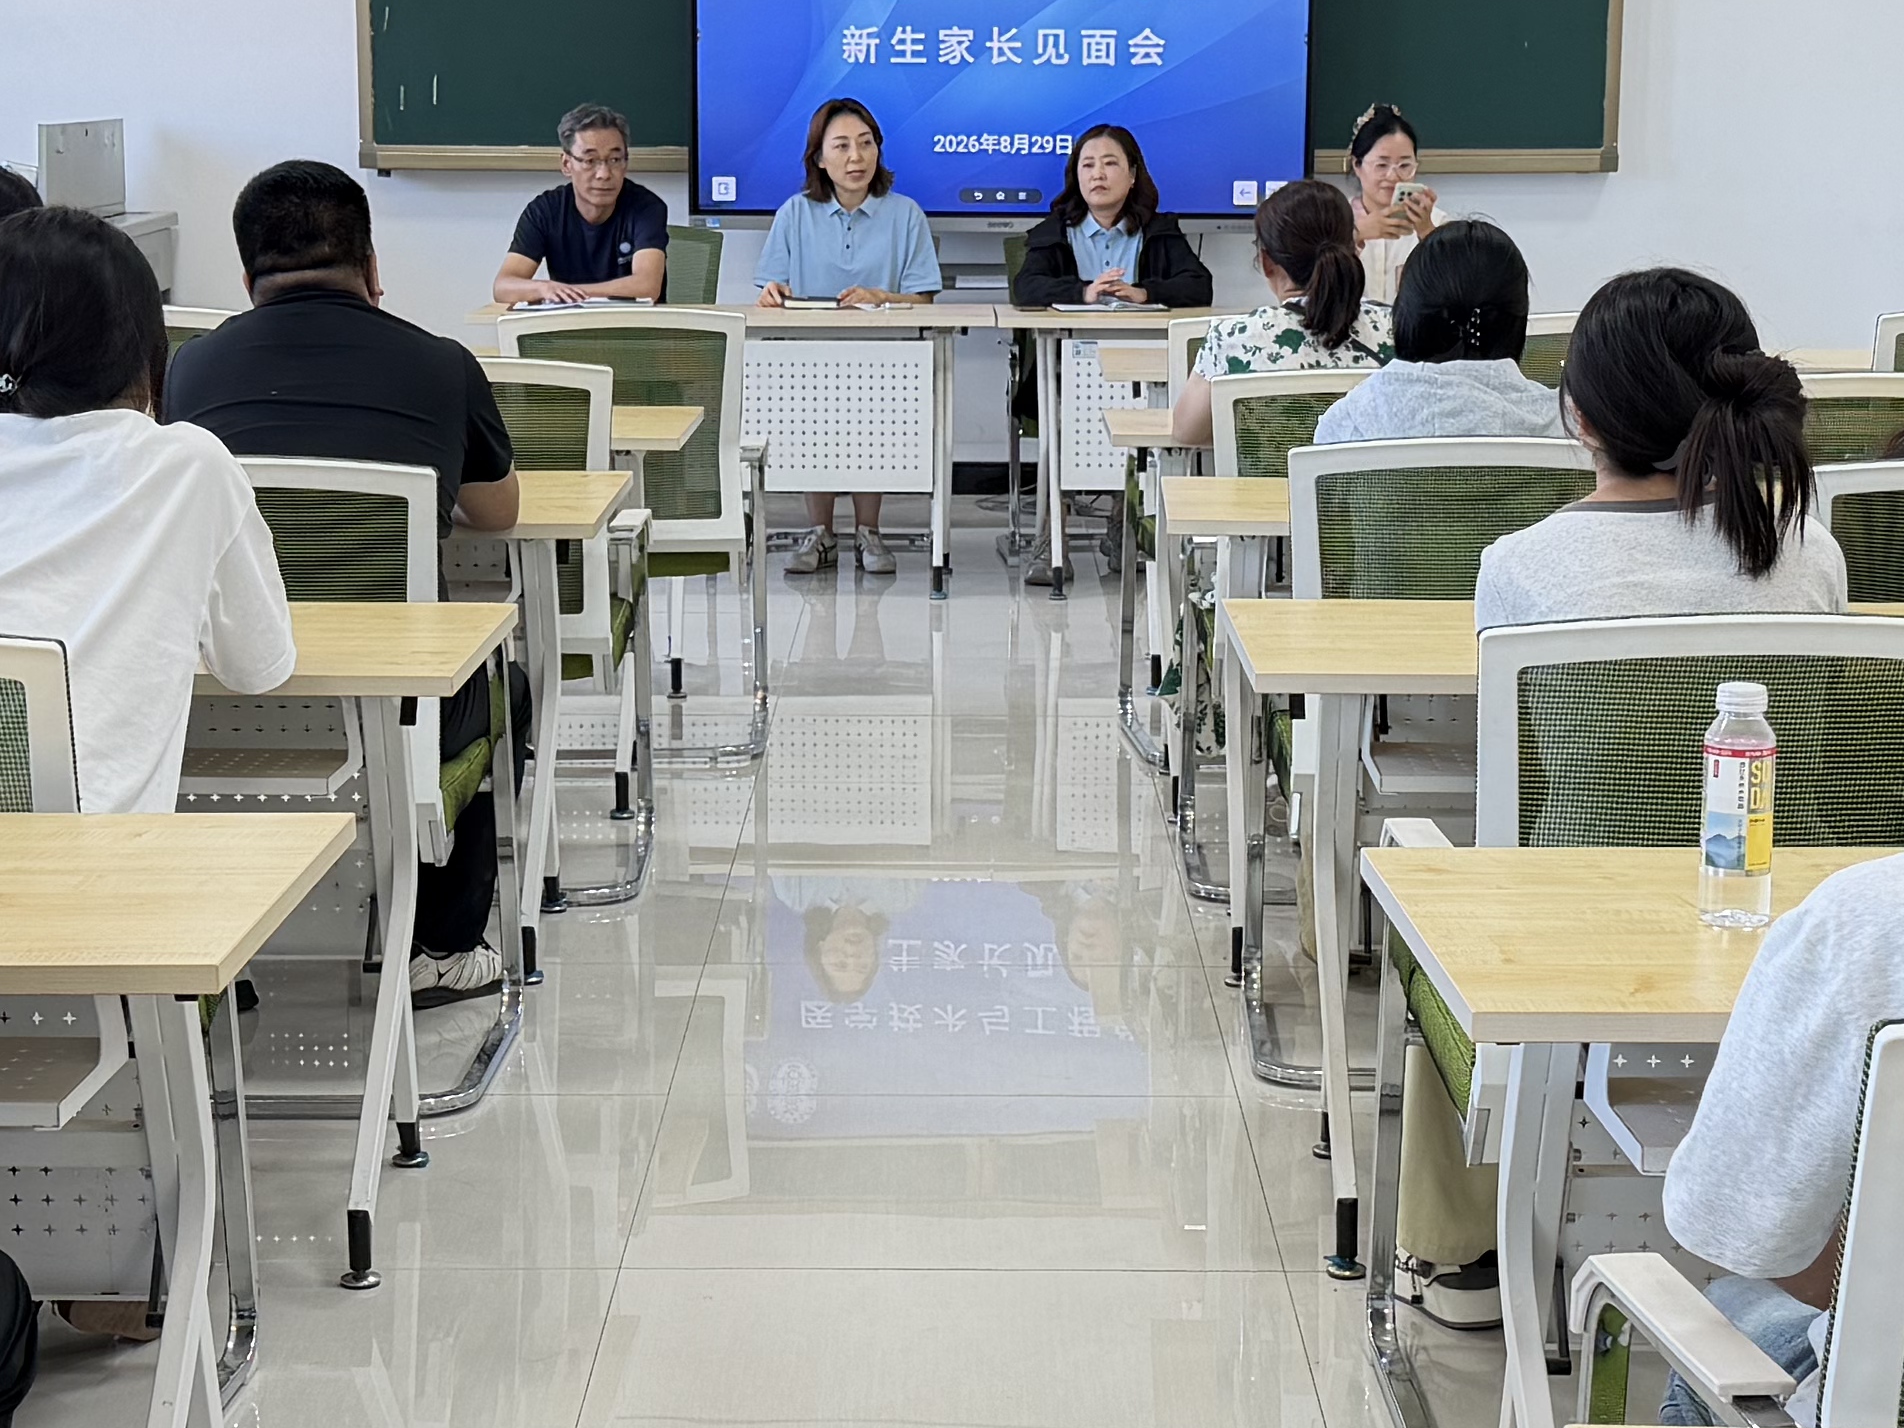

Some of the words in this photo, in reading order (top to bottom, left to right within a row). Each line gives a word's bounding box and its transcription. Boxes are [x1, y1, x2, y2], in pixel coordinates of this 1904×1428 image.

[841, 25, 1167, 67] 新生家长见面会
[932, 133, 1074, 156] 2026年8月29日
